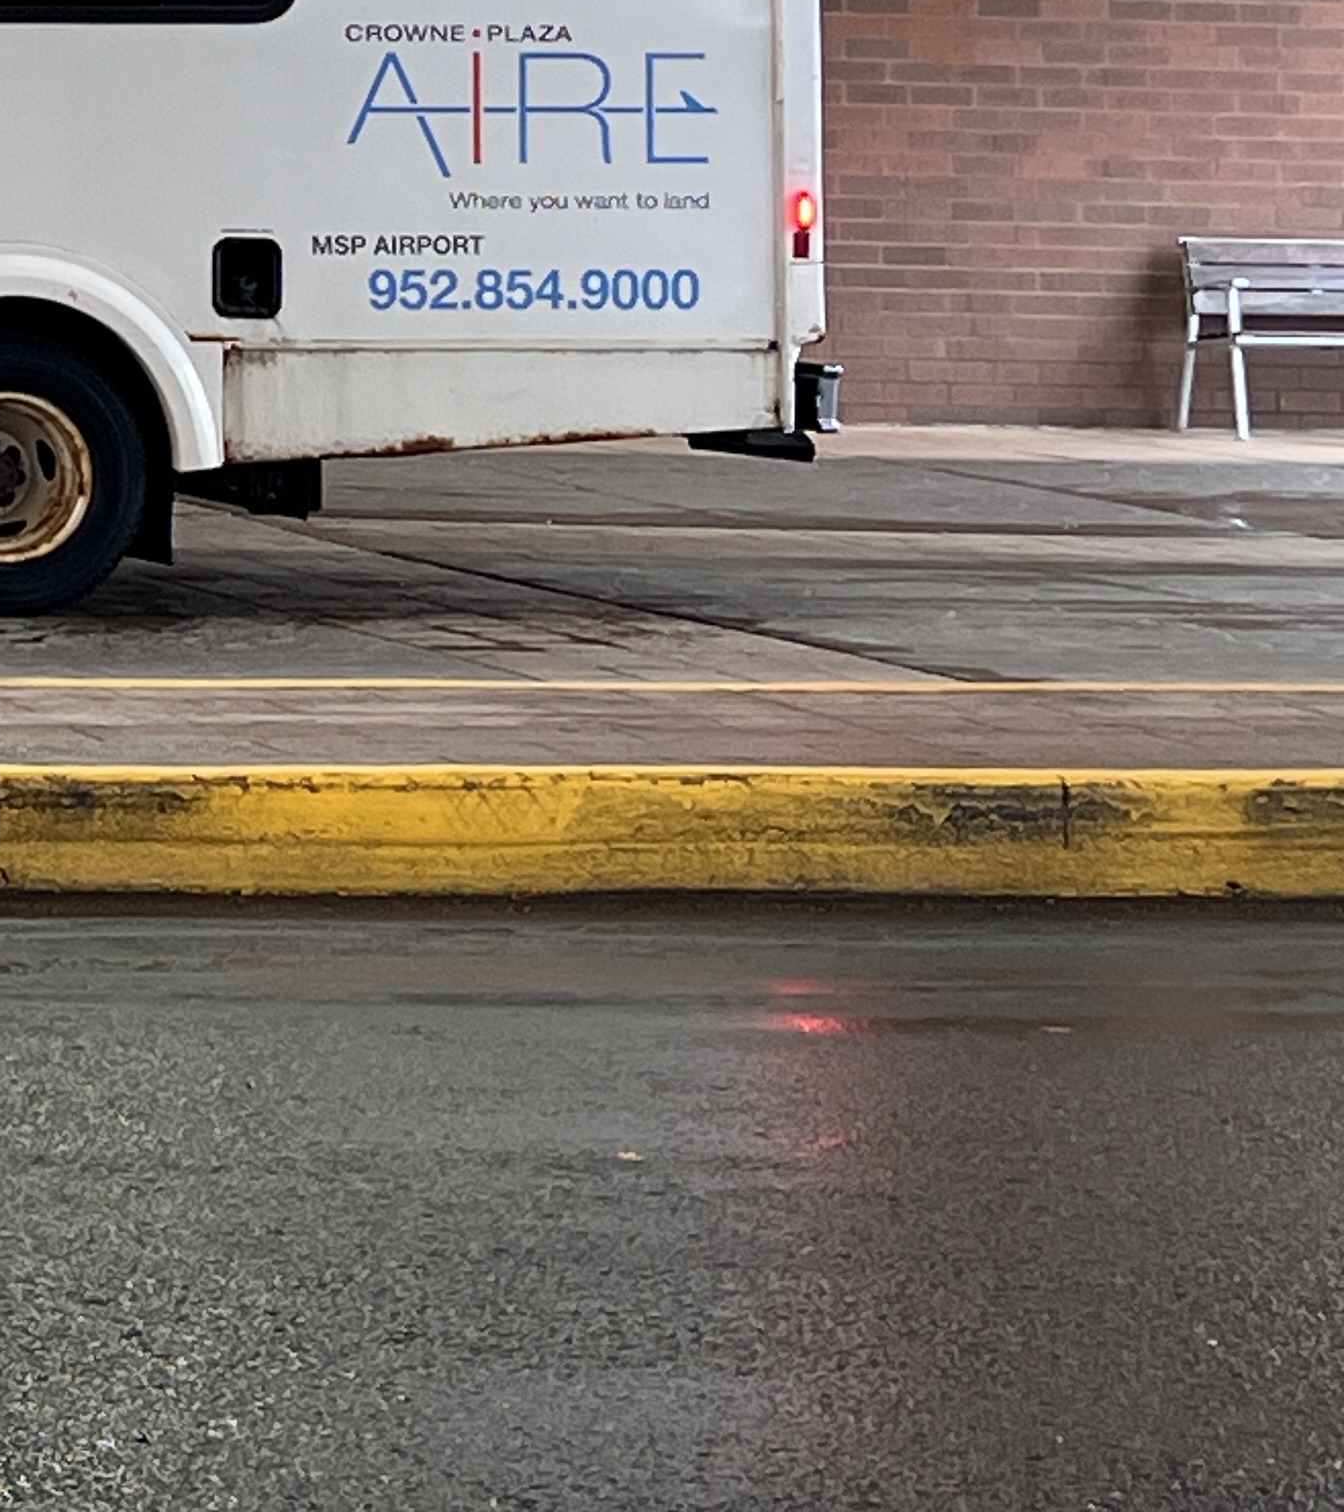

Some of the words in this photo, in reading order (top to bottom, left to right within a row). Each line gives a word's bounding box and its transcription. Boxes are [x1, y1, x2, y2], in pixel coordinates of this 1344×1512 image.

[344, 23, 467, 44] CROWNE
[486, 23, 573, 44] PLAZA
[346, 50, 718, 179] AIRE
[448, 191, 522, 210] Where
[528, 195, 569, 214] you
[574, 192, 630, 210] want
[636, 192, 659, 210] to
[663, 191, 710, 210] land
[311, 234, 367, 257] MSP
[372, 234, 486, 257] AIRPORT
[367, 268, 701, 312] 952.854.9000
